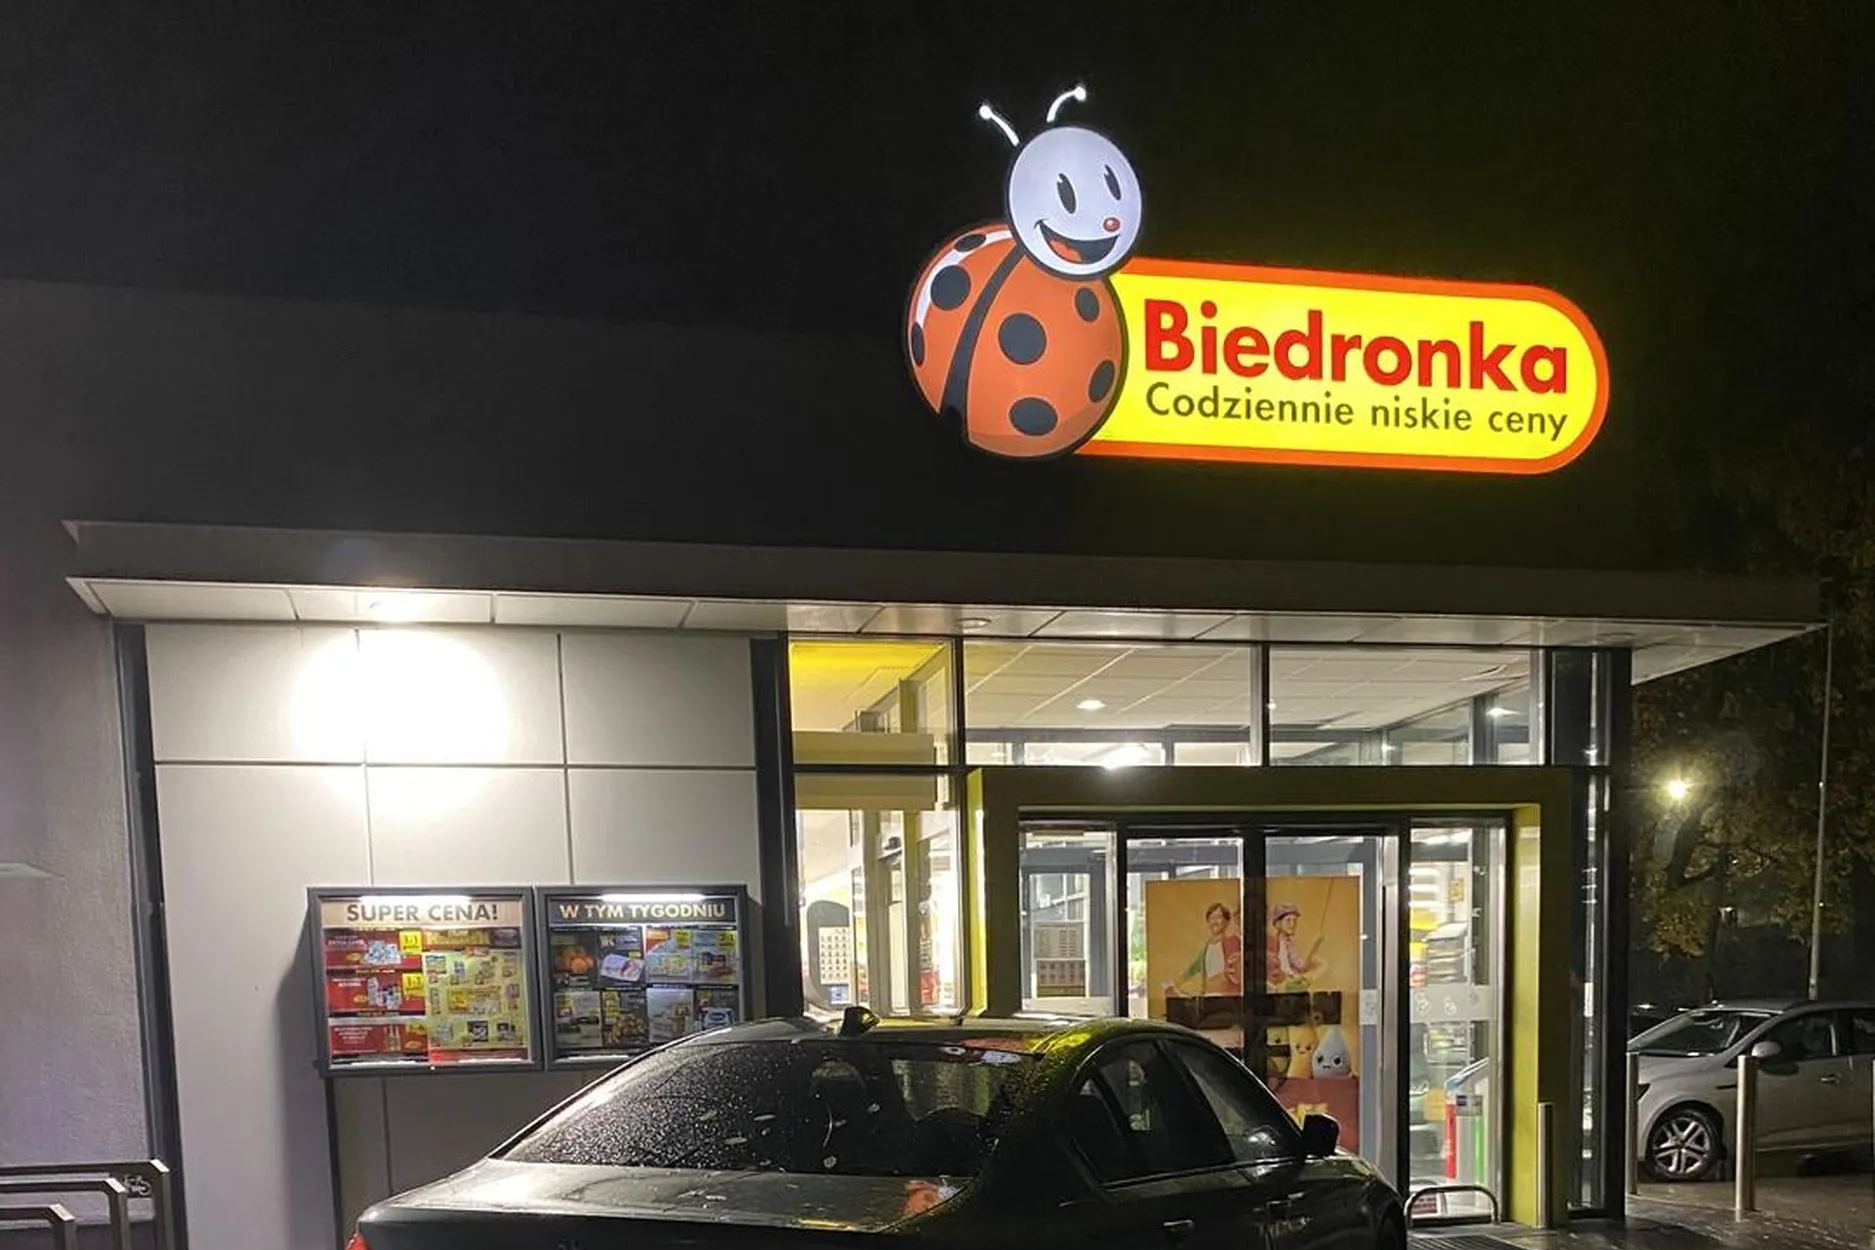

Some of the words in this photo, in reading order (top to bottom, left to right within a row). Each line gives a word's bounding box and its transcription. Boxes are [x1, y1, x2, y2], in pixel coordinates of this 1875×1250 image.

[1145, 300, 1567, 394] Biedronka
[1146, 381, 1354, 425] Codziennie
[1371, 397, 1472, 431] niskie
[1488, 411, 1568, 442] ceny
[347, 904, 419, 921] SUPER
[428, 904, 498, 920] CENA!
[559, 904, 579, 918] W
[585, 904, 624, 918] TYM
[628, 903, 726, 918] TYGODNIU
